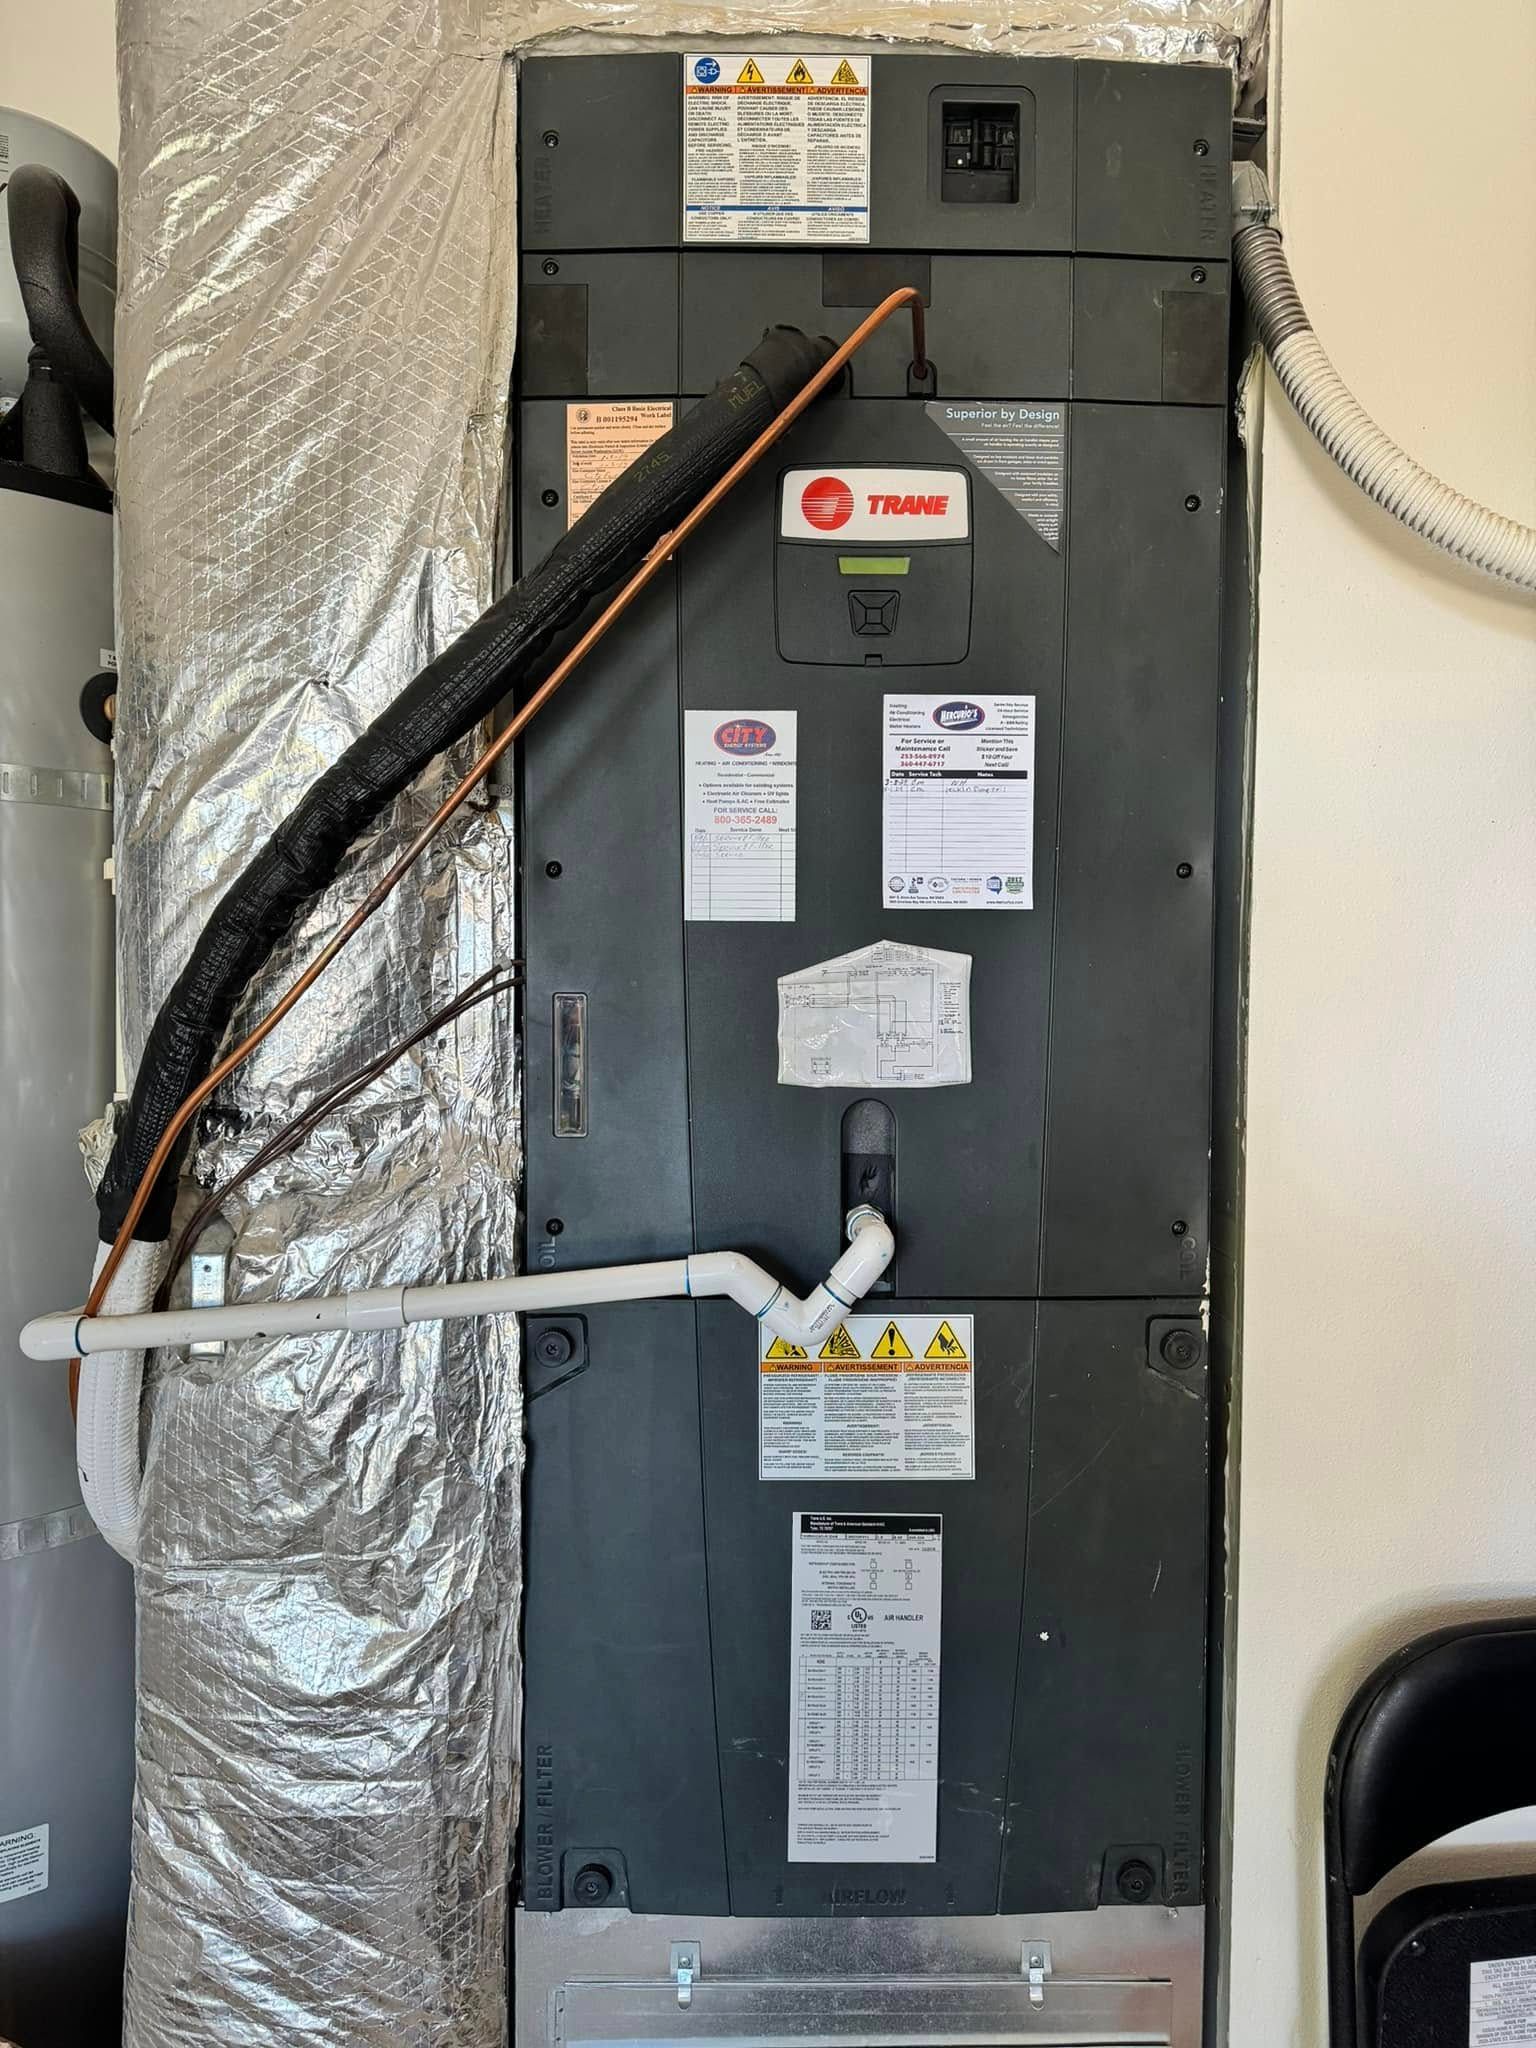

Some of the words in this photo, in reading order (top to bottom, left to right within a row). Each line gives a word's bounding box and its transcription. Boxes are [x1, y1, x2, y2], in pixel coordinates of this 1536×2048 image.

[817, 87, 867, 95] ADVERTENCIA
[946, 407, 998, 421] Superior
[1000, 408, 1016, 422] by
[1019, 408, 1060, 422] Design
[866, 494, 950, 516] TRANE
[721, 726, 769, 744] CITY
[714, 815, 777, 824] 800-365-2489
[538, 1236, 556, 1268] OIL
[835, 1363, 898, 1371] AVERTISSEMENT
[914, 1363, 969, 1371] ADVERTENCIA
[536, 1744, 553, 1808] FILTER
[0, 1832, 34, 1847] ARNING
[536, 1823, 553, 1901] BLOWER
[1172, 1831, 1191, 1895] FILTER
